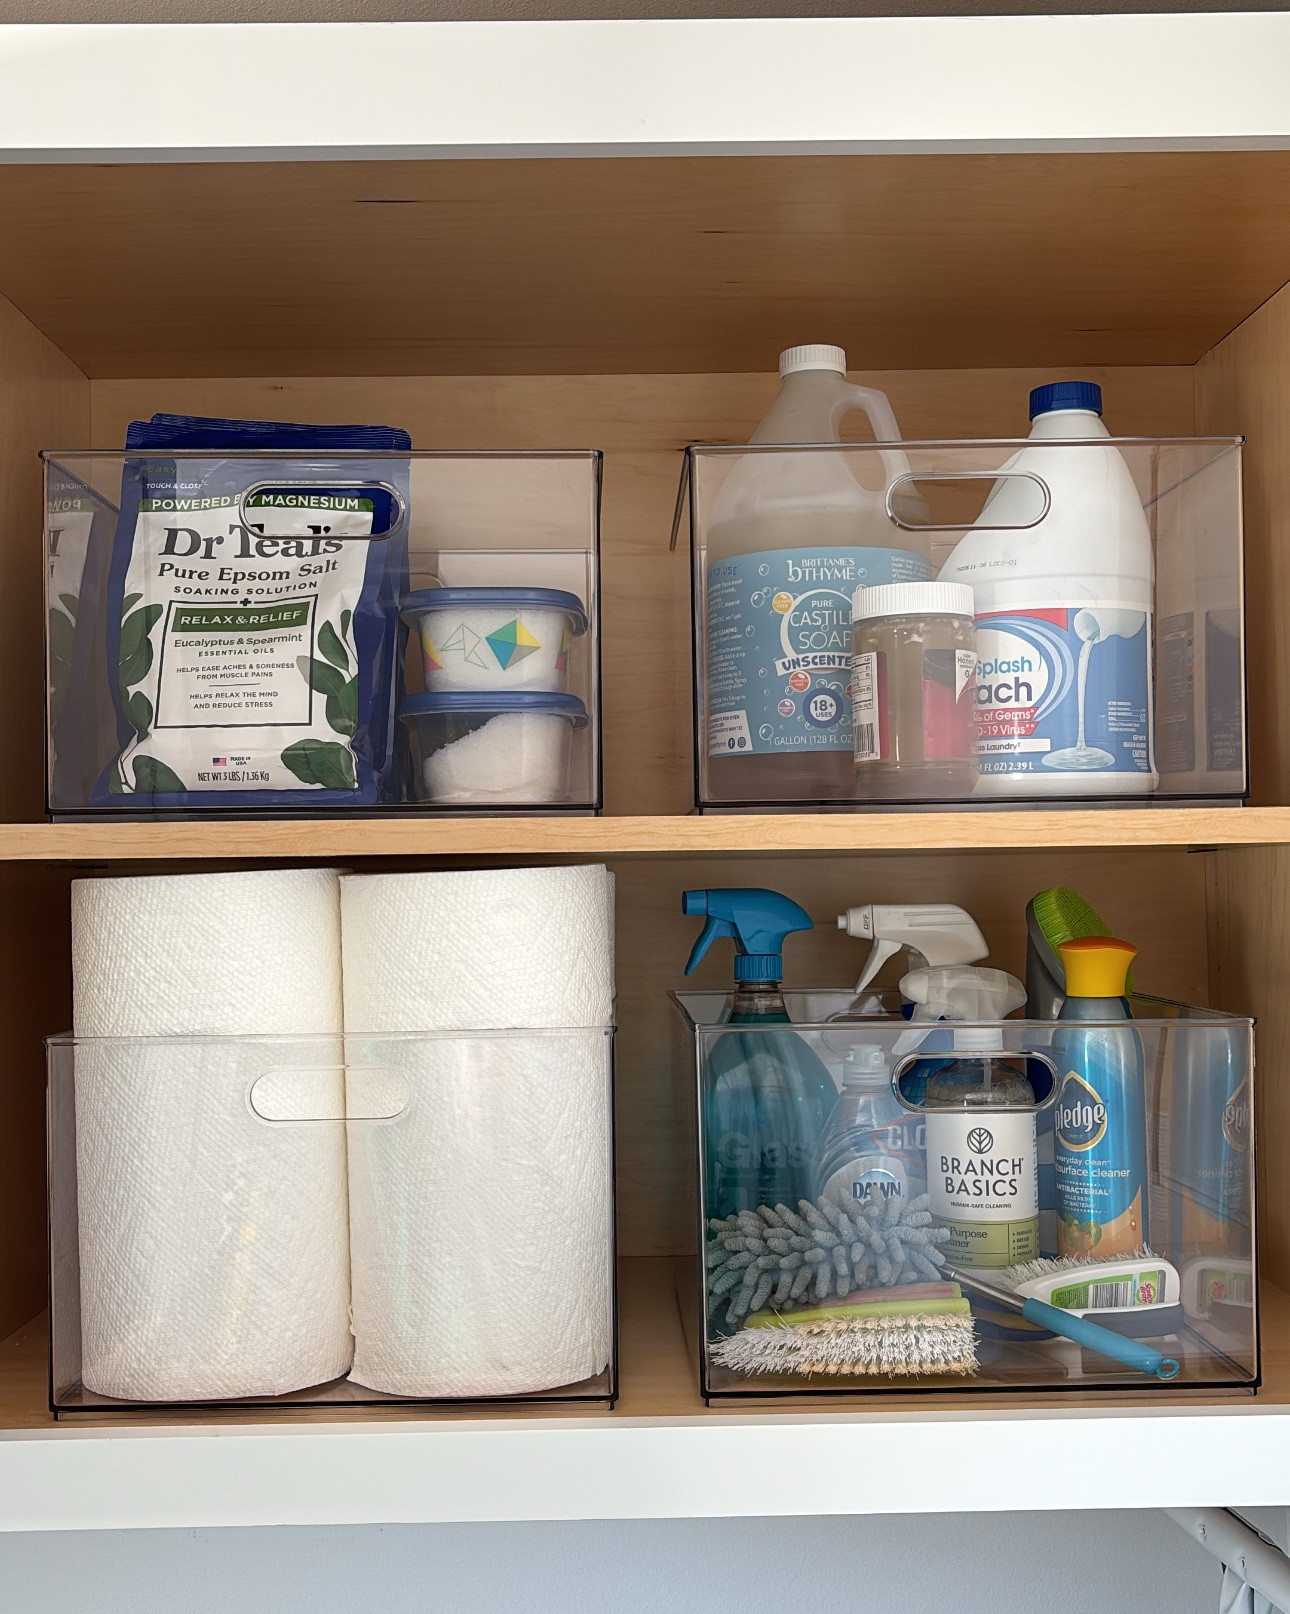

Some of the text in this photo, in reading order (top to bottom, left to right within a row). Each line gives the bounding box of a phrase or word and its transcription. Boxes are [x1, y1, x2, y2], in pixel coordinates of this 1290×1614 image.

[152, 493, 359, 511] POWERED BY MAGNESIUM
[158, 524, 344, 560] Dr Teal's
[802, 558, 855, 567] BRITTANIE'S
[158, 559, 339, 585] Pure Epsom Salt
[723, 566, 738, 576] USE
[802, 567, 855, 581] THYME
[173, 581, 318, 595] SOAKING SOLUTION
[811, 600, 833, 608] PURE
[174, 633, 303, 649] Eucalyptus & Spearmint
[198, 649, 249, 657] ESSENTIAL
[781, 655, 852, 671] UNSCENTE
[977, 677, 1033, 704] ach
[813, 700, 835, 712] 18+
[984, 711, 993, 721] of
[774, 735, 807, 746] GALLON
[809, 734, 828, 745] (128
[830, 735, 839, 744] FL
[984, 762, 993, 772] FL
[994, 761, 1007, 772] OZ)
[1008, 761, 1027, 771] 2.39
[198, 772, 211, 782] NET
[211, 772, 222, 781] WT
[223, 772, 228, 781] 3
[228, 772, 241, 781] LBS
[246, 771, 259, 781] 1.36
[260, 771, 270, 782] Kg
[1055, 1101, 1105, 1137] pledge
[718, 1131, 808, 1168] Glas
[940, 1156, 1020, 1177] BRANCH
[1091, 1168, 1131, 1178] cleaner
[945, 1178, 1018, 1196] BASICS
[950, 1201, 984, 1209] HUMAN-SAFE
[950, 1226, 988, 1240] Purpose
[946, 1239, 970, 1248] eaner
